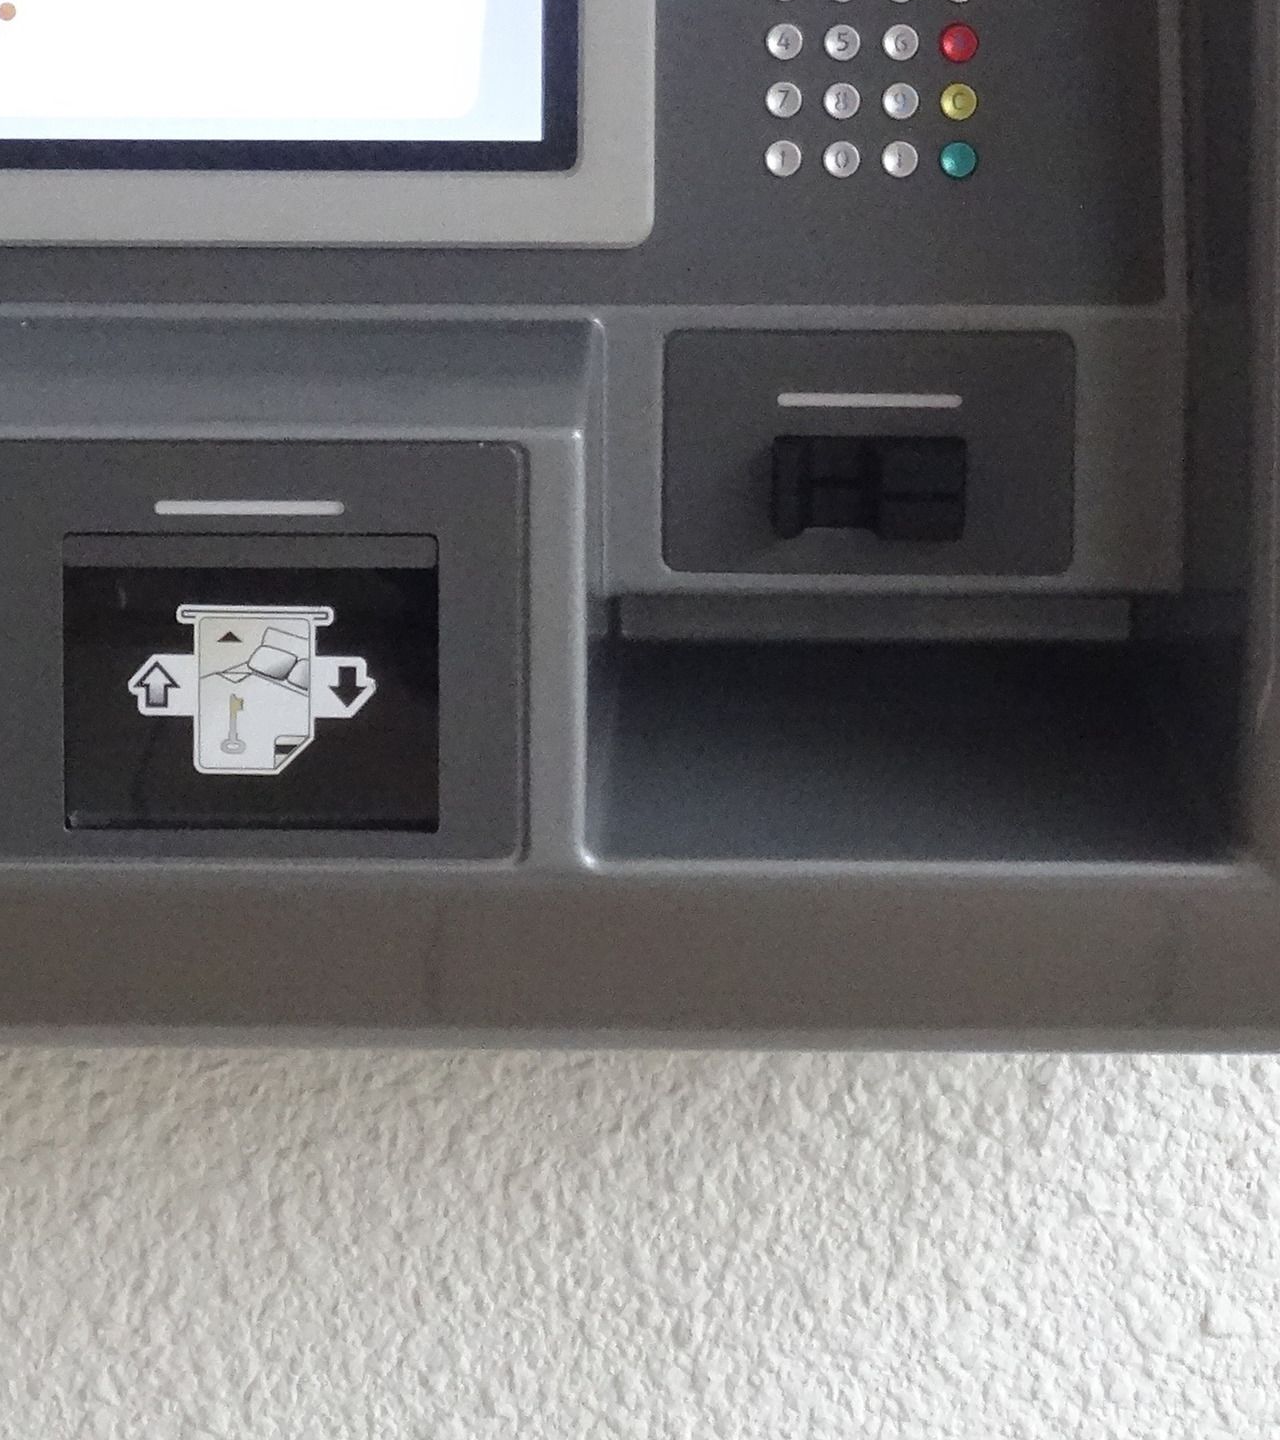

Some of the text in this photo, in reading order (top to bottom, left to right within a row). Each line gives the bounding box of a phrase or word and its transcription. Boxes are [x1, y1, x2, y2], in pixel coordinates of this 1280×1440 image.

[776, 30, 908, 53] 4 5 6
[777, 89, 791, 110] 7
